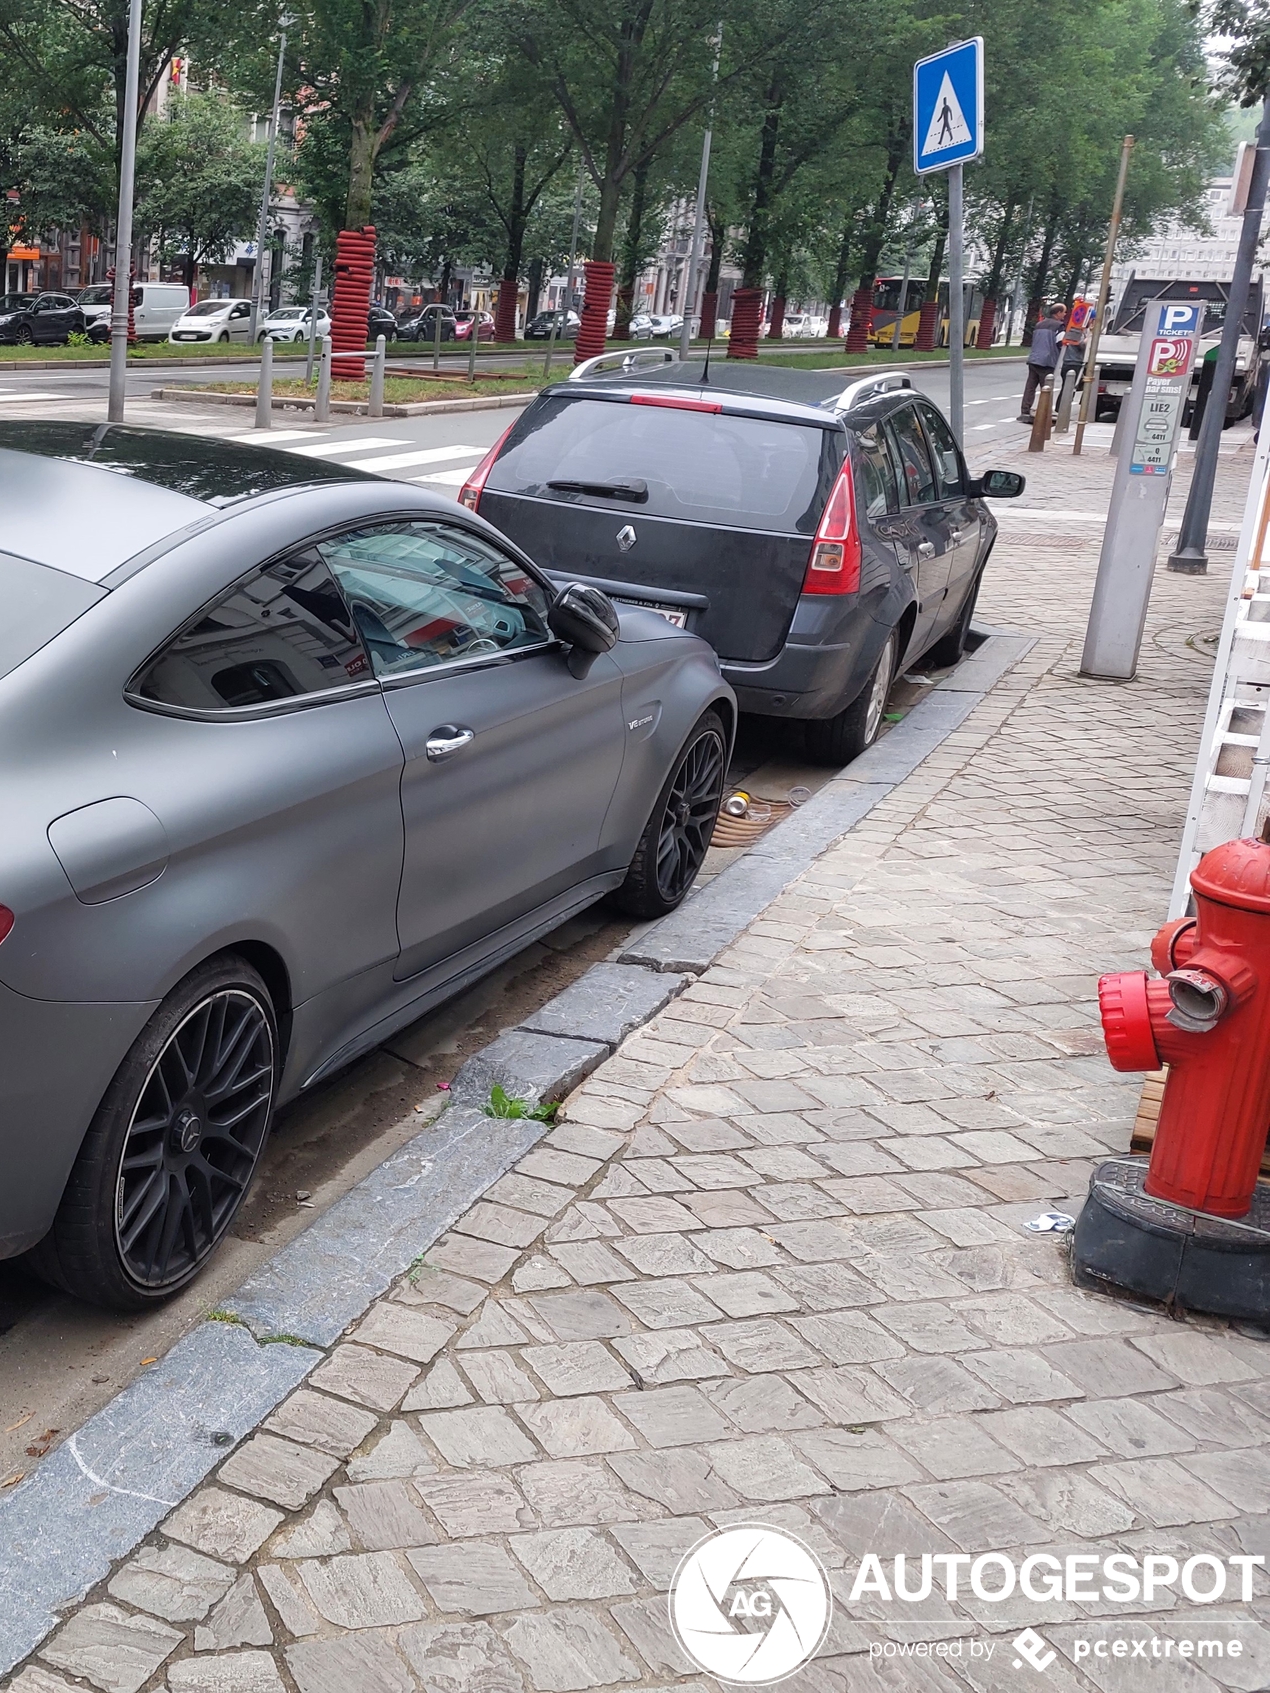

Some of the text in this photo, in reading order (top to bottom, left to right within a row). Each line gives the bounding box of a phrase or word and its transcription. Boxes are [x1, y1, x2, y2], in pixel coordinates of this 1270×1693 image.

[1164, 306, 1193, 330] P
[1146, 376, 1172, 387] Payer
[1145, 385, 1182, 395] par sms!
[1149, 403, 1171, 413] LIE2
